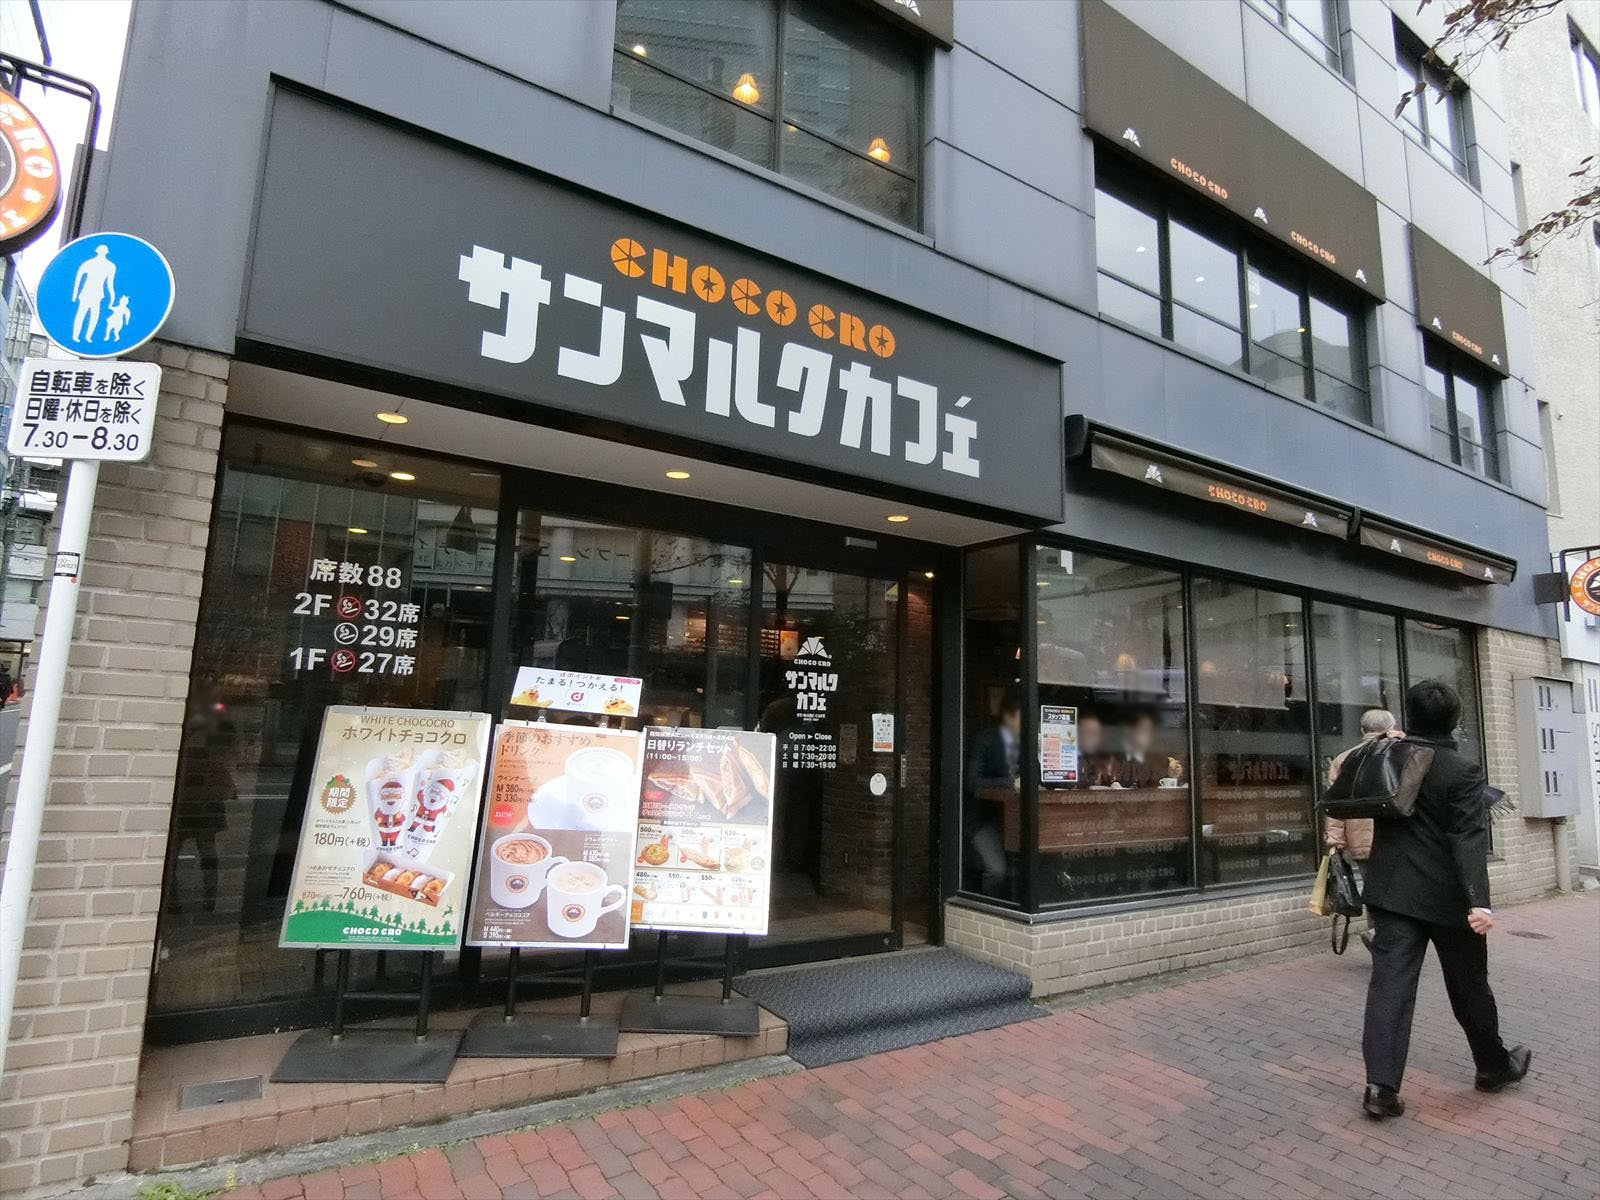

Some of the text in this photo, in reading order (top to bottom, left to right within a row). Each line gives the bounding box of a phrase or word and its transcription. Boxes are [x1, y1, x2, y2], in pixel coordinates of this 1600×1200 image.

[1171, 157, 1228, 199] CHOCO CRO
[1291, 230, 1335, 264] CHOCO CRO
[611, 237, 896, 358] CHOCO CRO
[458, 245, 980, 478] サンマルクカフェ
[30, 369, 146, 397] 自転車を除く
[25, 397, 142, 424] 日曜・休日を除く
[1208, 484, 1267, 512] CHOCO CRO
[310, 559, 401, 588] 席数88
[293, 592, 420, 623] 2F 32席
[360, 625, 418, 648] 29席
[290, 647, 416, 675] 1F 27席
[785, 670, 838, 691] サンマルク
[796, 691, 826, 711] カフェ
[360, 715, 455, 729] WHITE CHOCOCRO
[342, 726, 466, 745] ホワイトチョコクロ
[503, 731, 591, 746] 季節のおすすめ
[789, 732, 832, 741] Open Close
[500, 744, 540, 756] ドリンク
[647, 739, 732, 753] 日替りランチセット
[328, 787, 350, 797] 期間
[496, 784, 503, 793] M
[496, 793, 502, 802] S
[326, 798, 347, 808] 限定
[314, 833, 371, 848] 180円(+税)
[343, 927, 402, 936] CHOCO CRO
